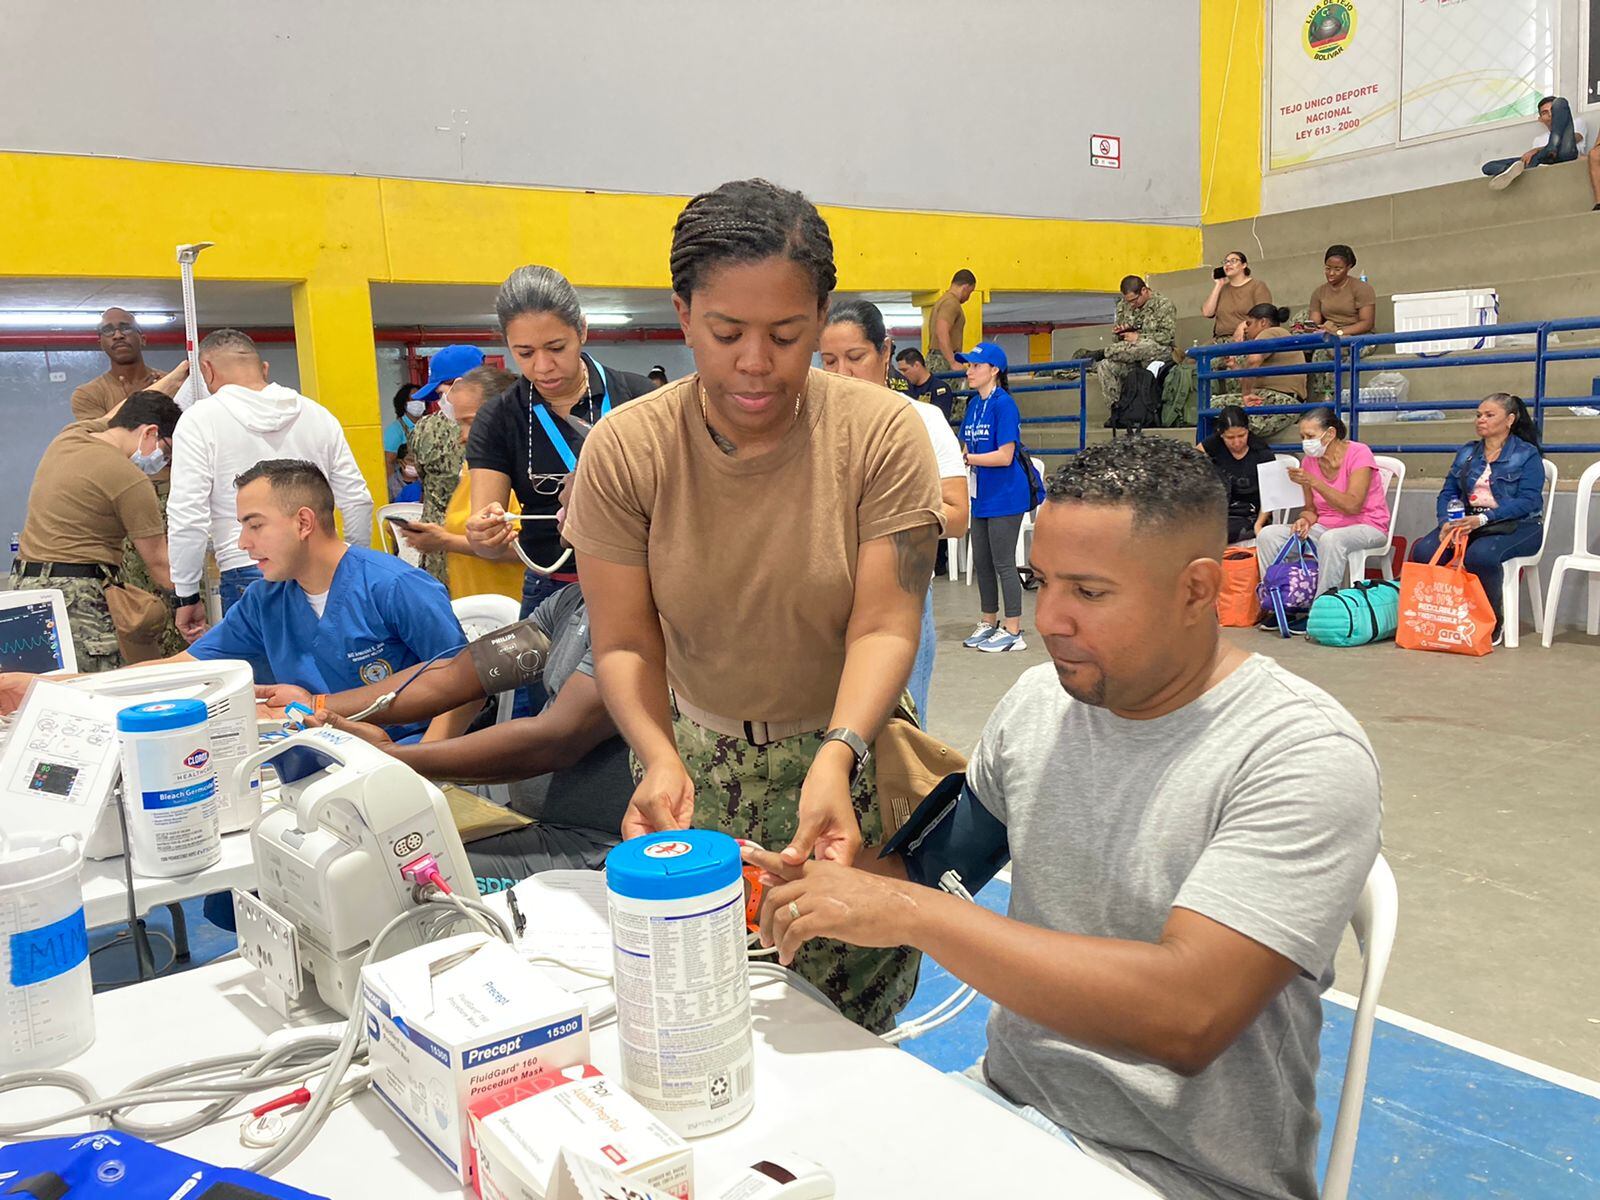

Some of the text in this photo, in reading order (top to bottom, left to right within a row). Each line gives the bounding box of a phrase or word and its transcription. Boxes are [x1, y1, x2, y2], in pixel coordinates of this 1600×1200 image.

[1306, 5, 1321, 24] LIGA
[1314, 46, 1344, 61] BOLIVAR
[1280, 84, 1379, 116] TEJO UNICO DEPORTE
[1306, 106, 1352, 124] NACIONAL
[1296, 130, 1312, 140] LEY
[1314, 125, 1331, 136] 613
[1338, 118, 1360, 131] 2000
[491, 633, 516, 645] PHILIPS
[1440, 630, 1461, 641] ara
[160, 791, 185, 801] Bleach
[547, 1021, 578, 1038] 15300
[468, 1037, 522, 1065] Precept
[523, 1057, 538, 1069] 160
[470, 1067, 544, 1096] Procedure Mask
[492, 1076, 556, 1108] PAD
